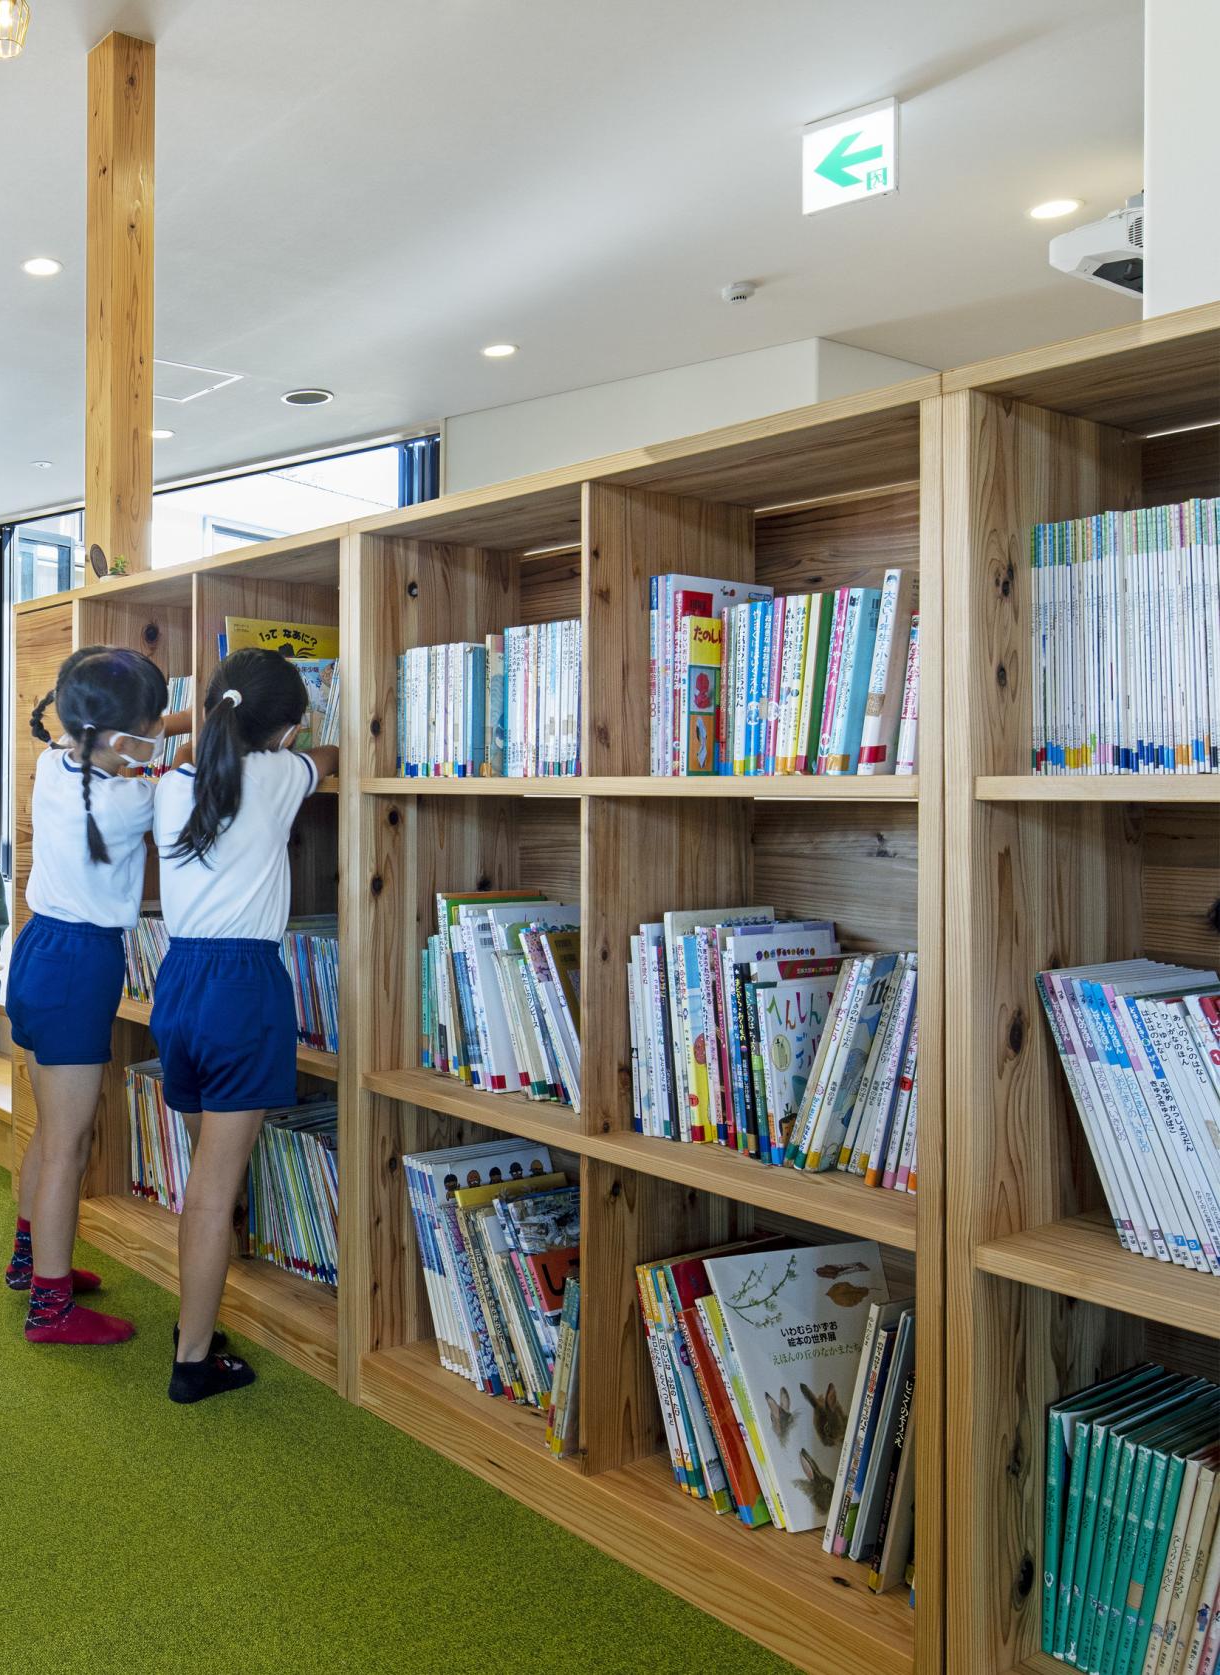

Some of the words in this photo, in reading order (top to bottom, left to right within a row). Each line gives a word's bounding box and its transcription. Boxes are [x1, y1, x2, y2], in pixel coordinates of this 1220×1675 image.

[258, 628, 278, 642] 1って
[1141, 1009, 1168, 1062] はははのはなし
[1150, 1011, 1172, 1048] てとゆび
[1172, 1013, 1207, 1084] あしのうらのはなし
[780, 1321, 838, 1337] いわむらかずお
[787, 1332, 837, 1347] 絵本の世界展
